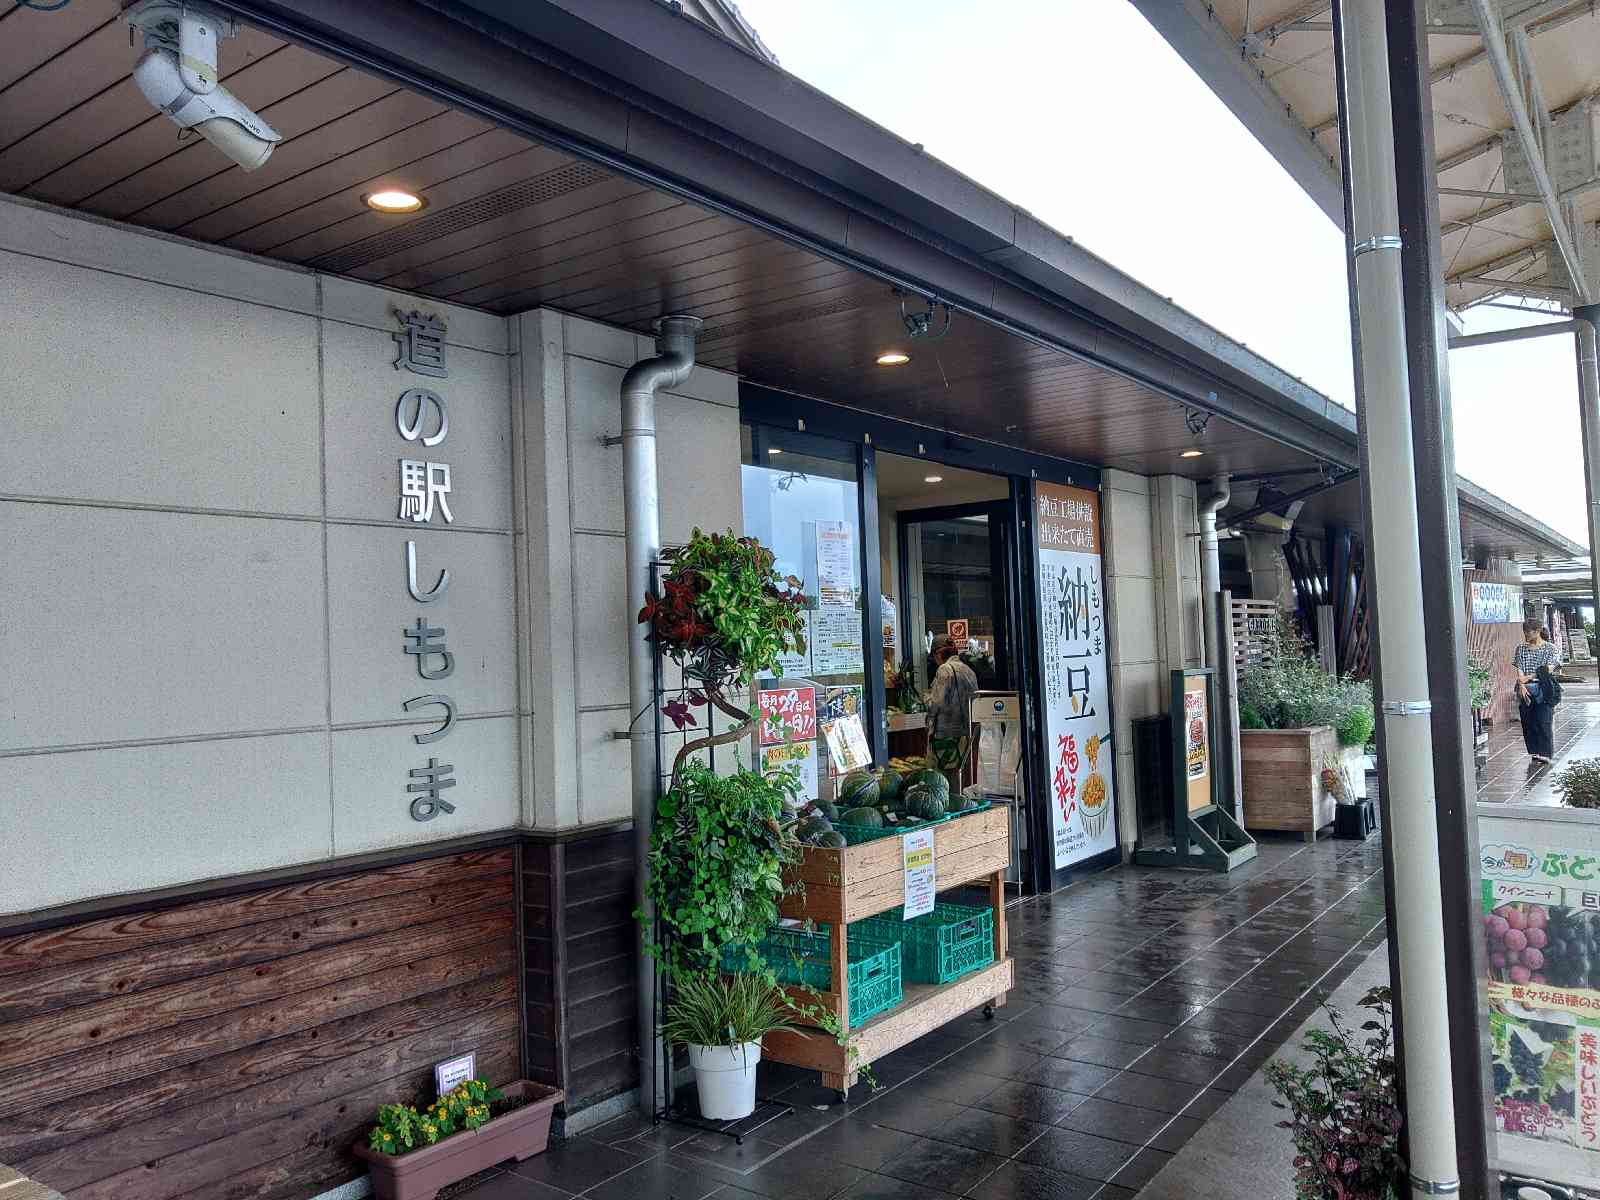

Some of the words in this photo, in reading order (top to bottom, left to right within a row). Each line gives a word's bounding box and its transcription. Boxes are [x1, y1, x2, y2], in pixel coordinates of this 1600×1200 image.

[391, 309, 457, 822] 道の駅しもつま
[1090, 565, 1102, 656] しもつま
[1057, 564, 1097, 720] 納豆
[1540, 852, 1600, 880] ぶど
[1582, 891, 1600, 911] 巨
